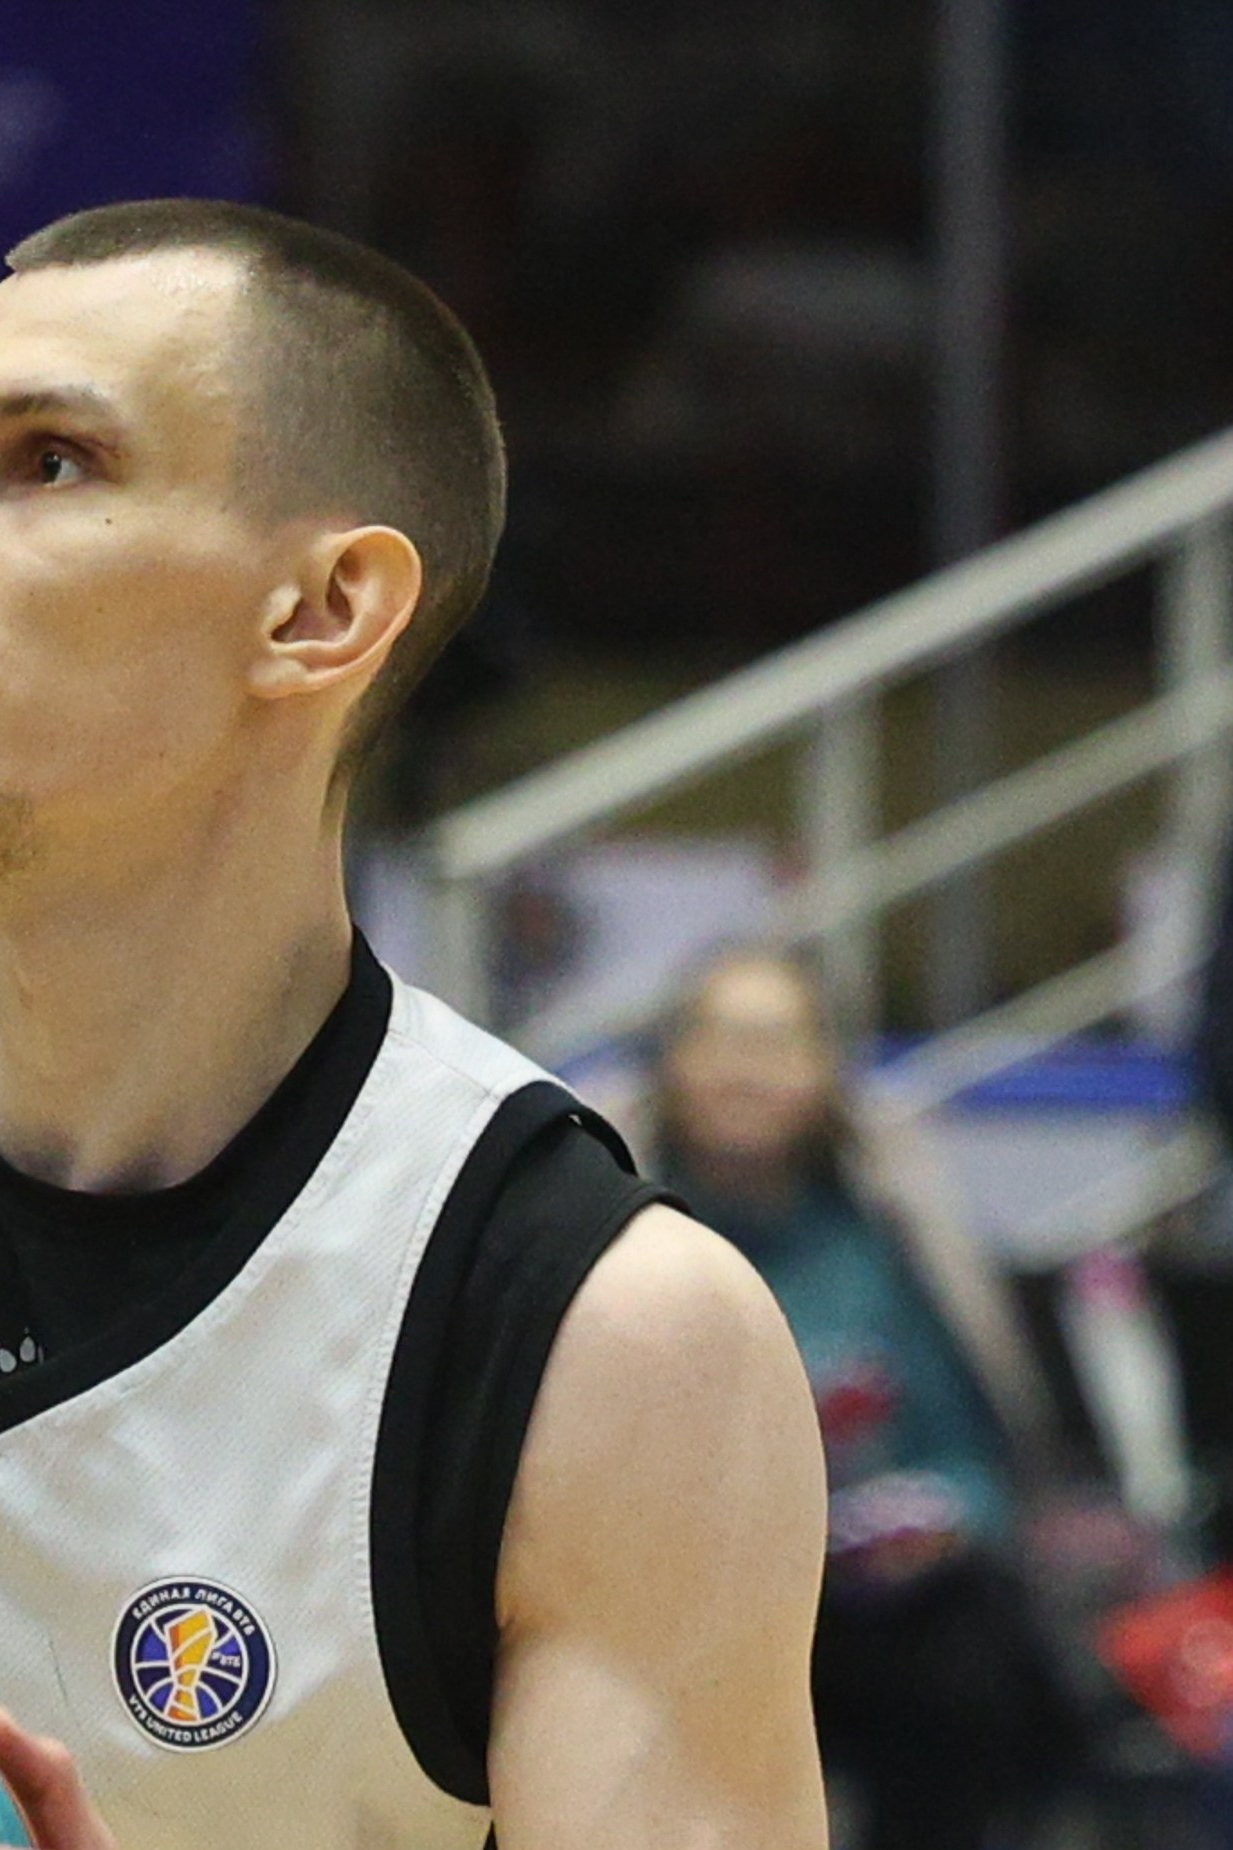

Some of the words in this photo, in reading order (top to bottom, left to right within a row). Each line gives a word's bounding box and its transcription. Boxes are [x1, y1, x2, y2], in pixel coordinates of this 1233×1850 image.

[133, 1588, 190, 1619] ЕДИНАЯ
[195, 1589, 233, 1612] ЛИГА
[148, 1718, 192, 1741] UNITED
[195, 1712, 243, 1741] LEAGUE
